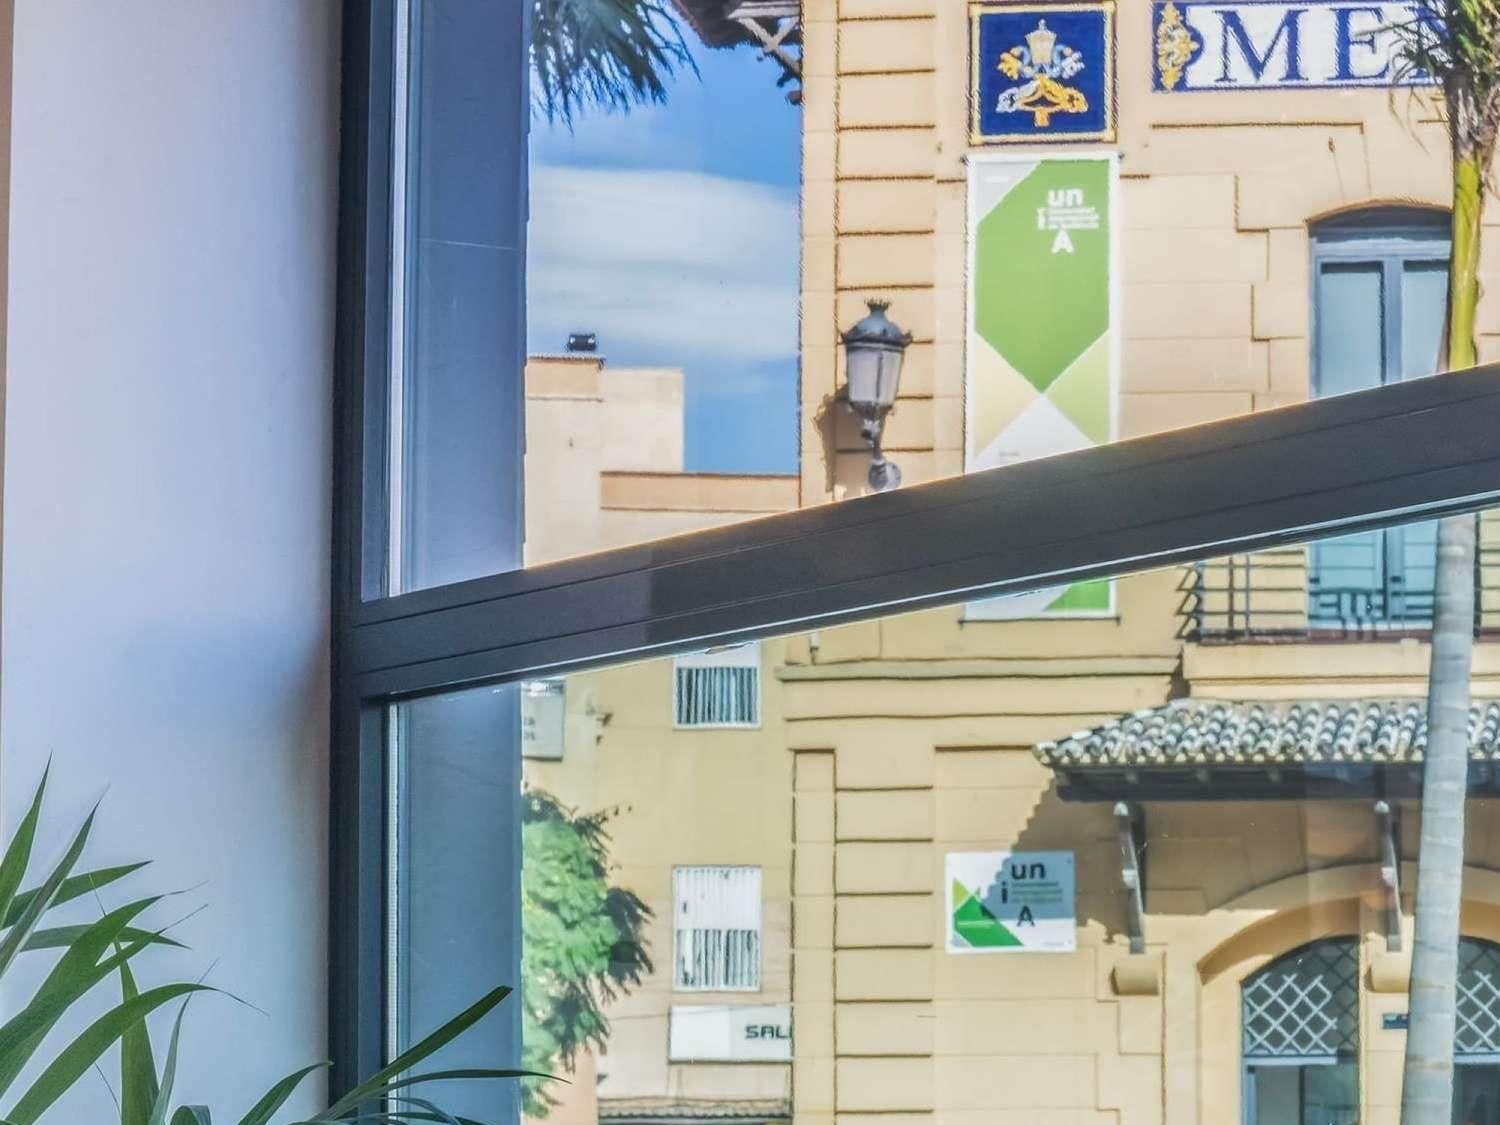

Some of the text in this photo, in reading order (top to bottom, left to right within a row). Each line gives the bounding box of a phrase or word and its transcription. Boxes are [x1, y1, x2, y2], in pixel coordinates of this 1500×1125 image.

[1051, 230, 1074, 253] A
[1011, 863, 1046, 880] un
[1016, 905, 1035, 927] A
[744, 1024, 792, 1040] SAL
